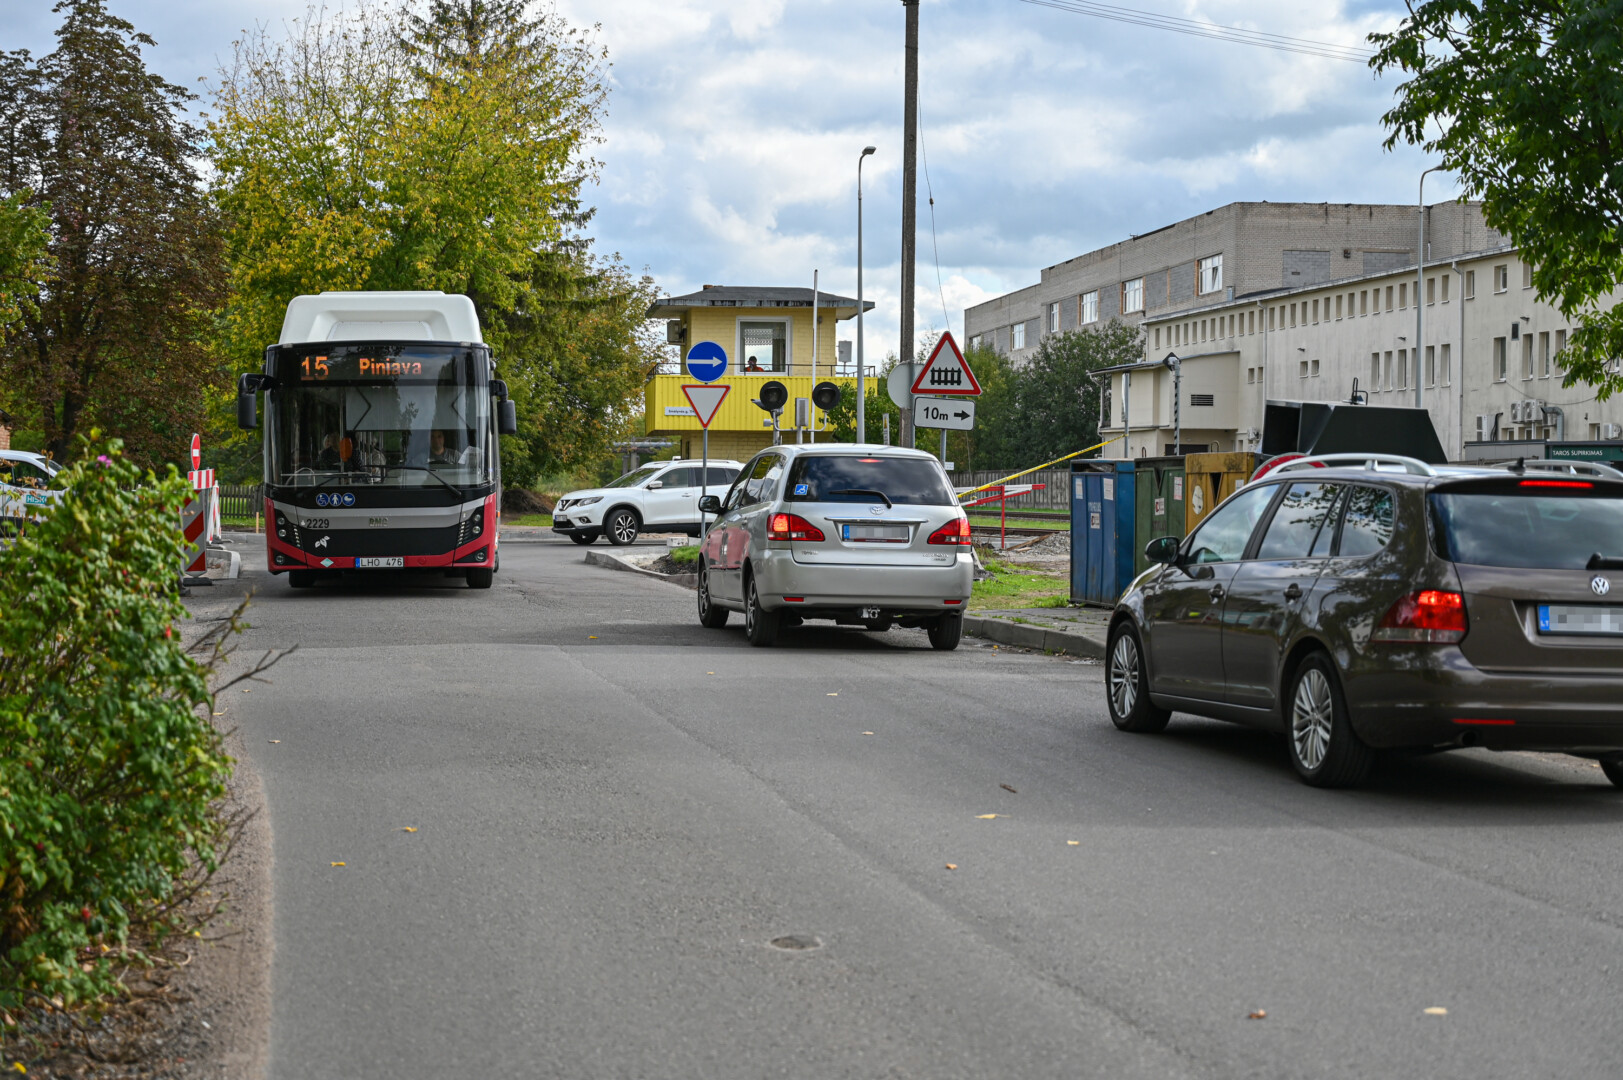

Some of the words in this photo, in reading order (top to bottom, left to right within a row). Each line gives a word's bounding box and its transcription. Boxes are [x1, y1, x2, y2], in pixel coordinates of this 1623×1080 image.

[301, 356, 329, 380] 15
[359, 358, 422, 375] Piniava
[923, 406, 949, 421] 10m
[306, 518, 330, 529] 2229
[360, 558, 381, 568] LHO
[385, 558, 403, 567] 476
